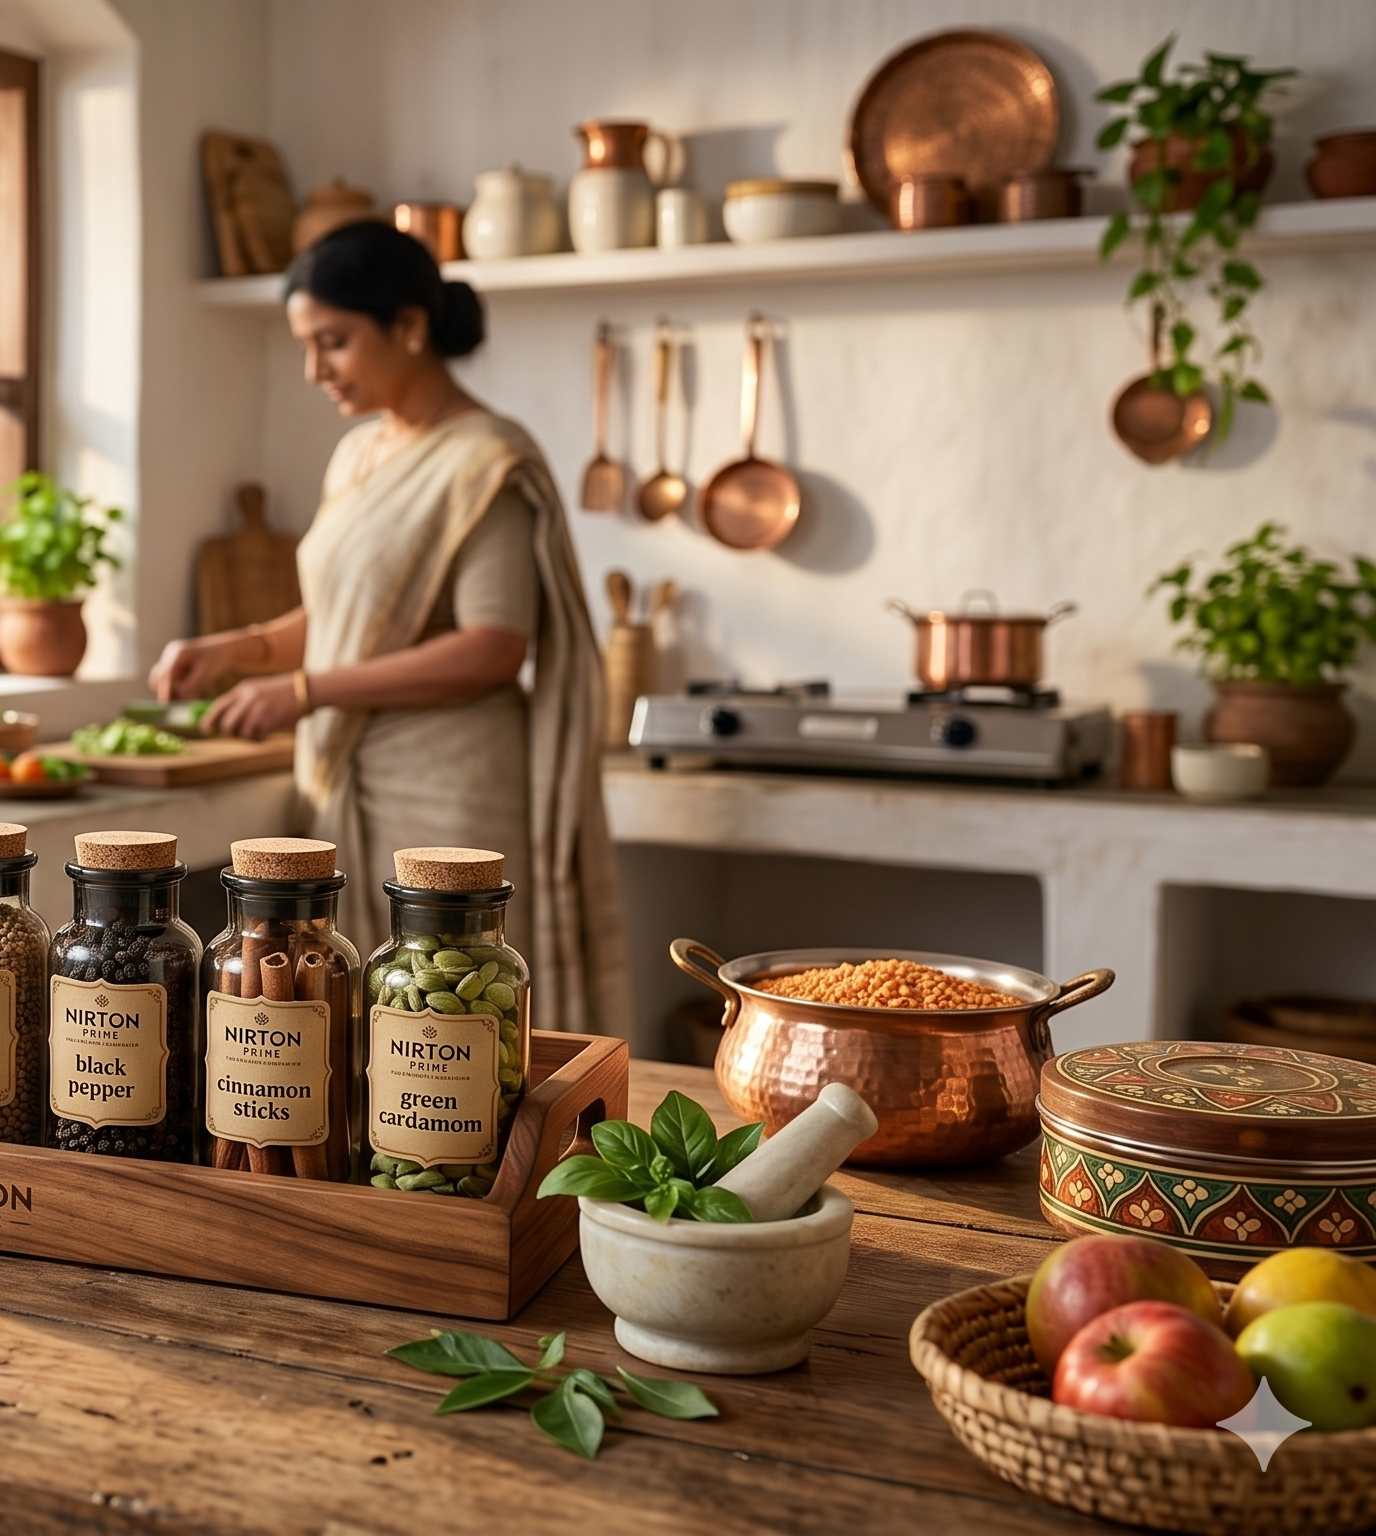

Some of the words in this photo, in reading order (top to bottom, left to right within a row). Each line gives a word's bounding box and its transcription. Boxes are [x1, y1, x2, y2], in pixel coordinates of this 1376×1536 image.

[66, 1008, 140, 1029] NIRTON
[83, 1029, 118, 1039] PRIME
[225, 1026, 301, 1047] NIRTON
[243, 1047, 280, 1058] PRIME
[390, 1039, 471, 1062] NIRTON
[75, 1054, 126, 1076] black
[410, 1061, 448, 1072] PRIME
[69, 1078, 135, 1102] pepper
[217, 1075, 311, 1099] cinnamon
[233, 1100, 290, 1120] sticks
[400, 1091, 457, 1110] green
[379, 1109, 482, 1133] cardamom
